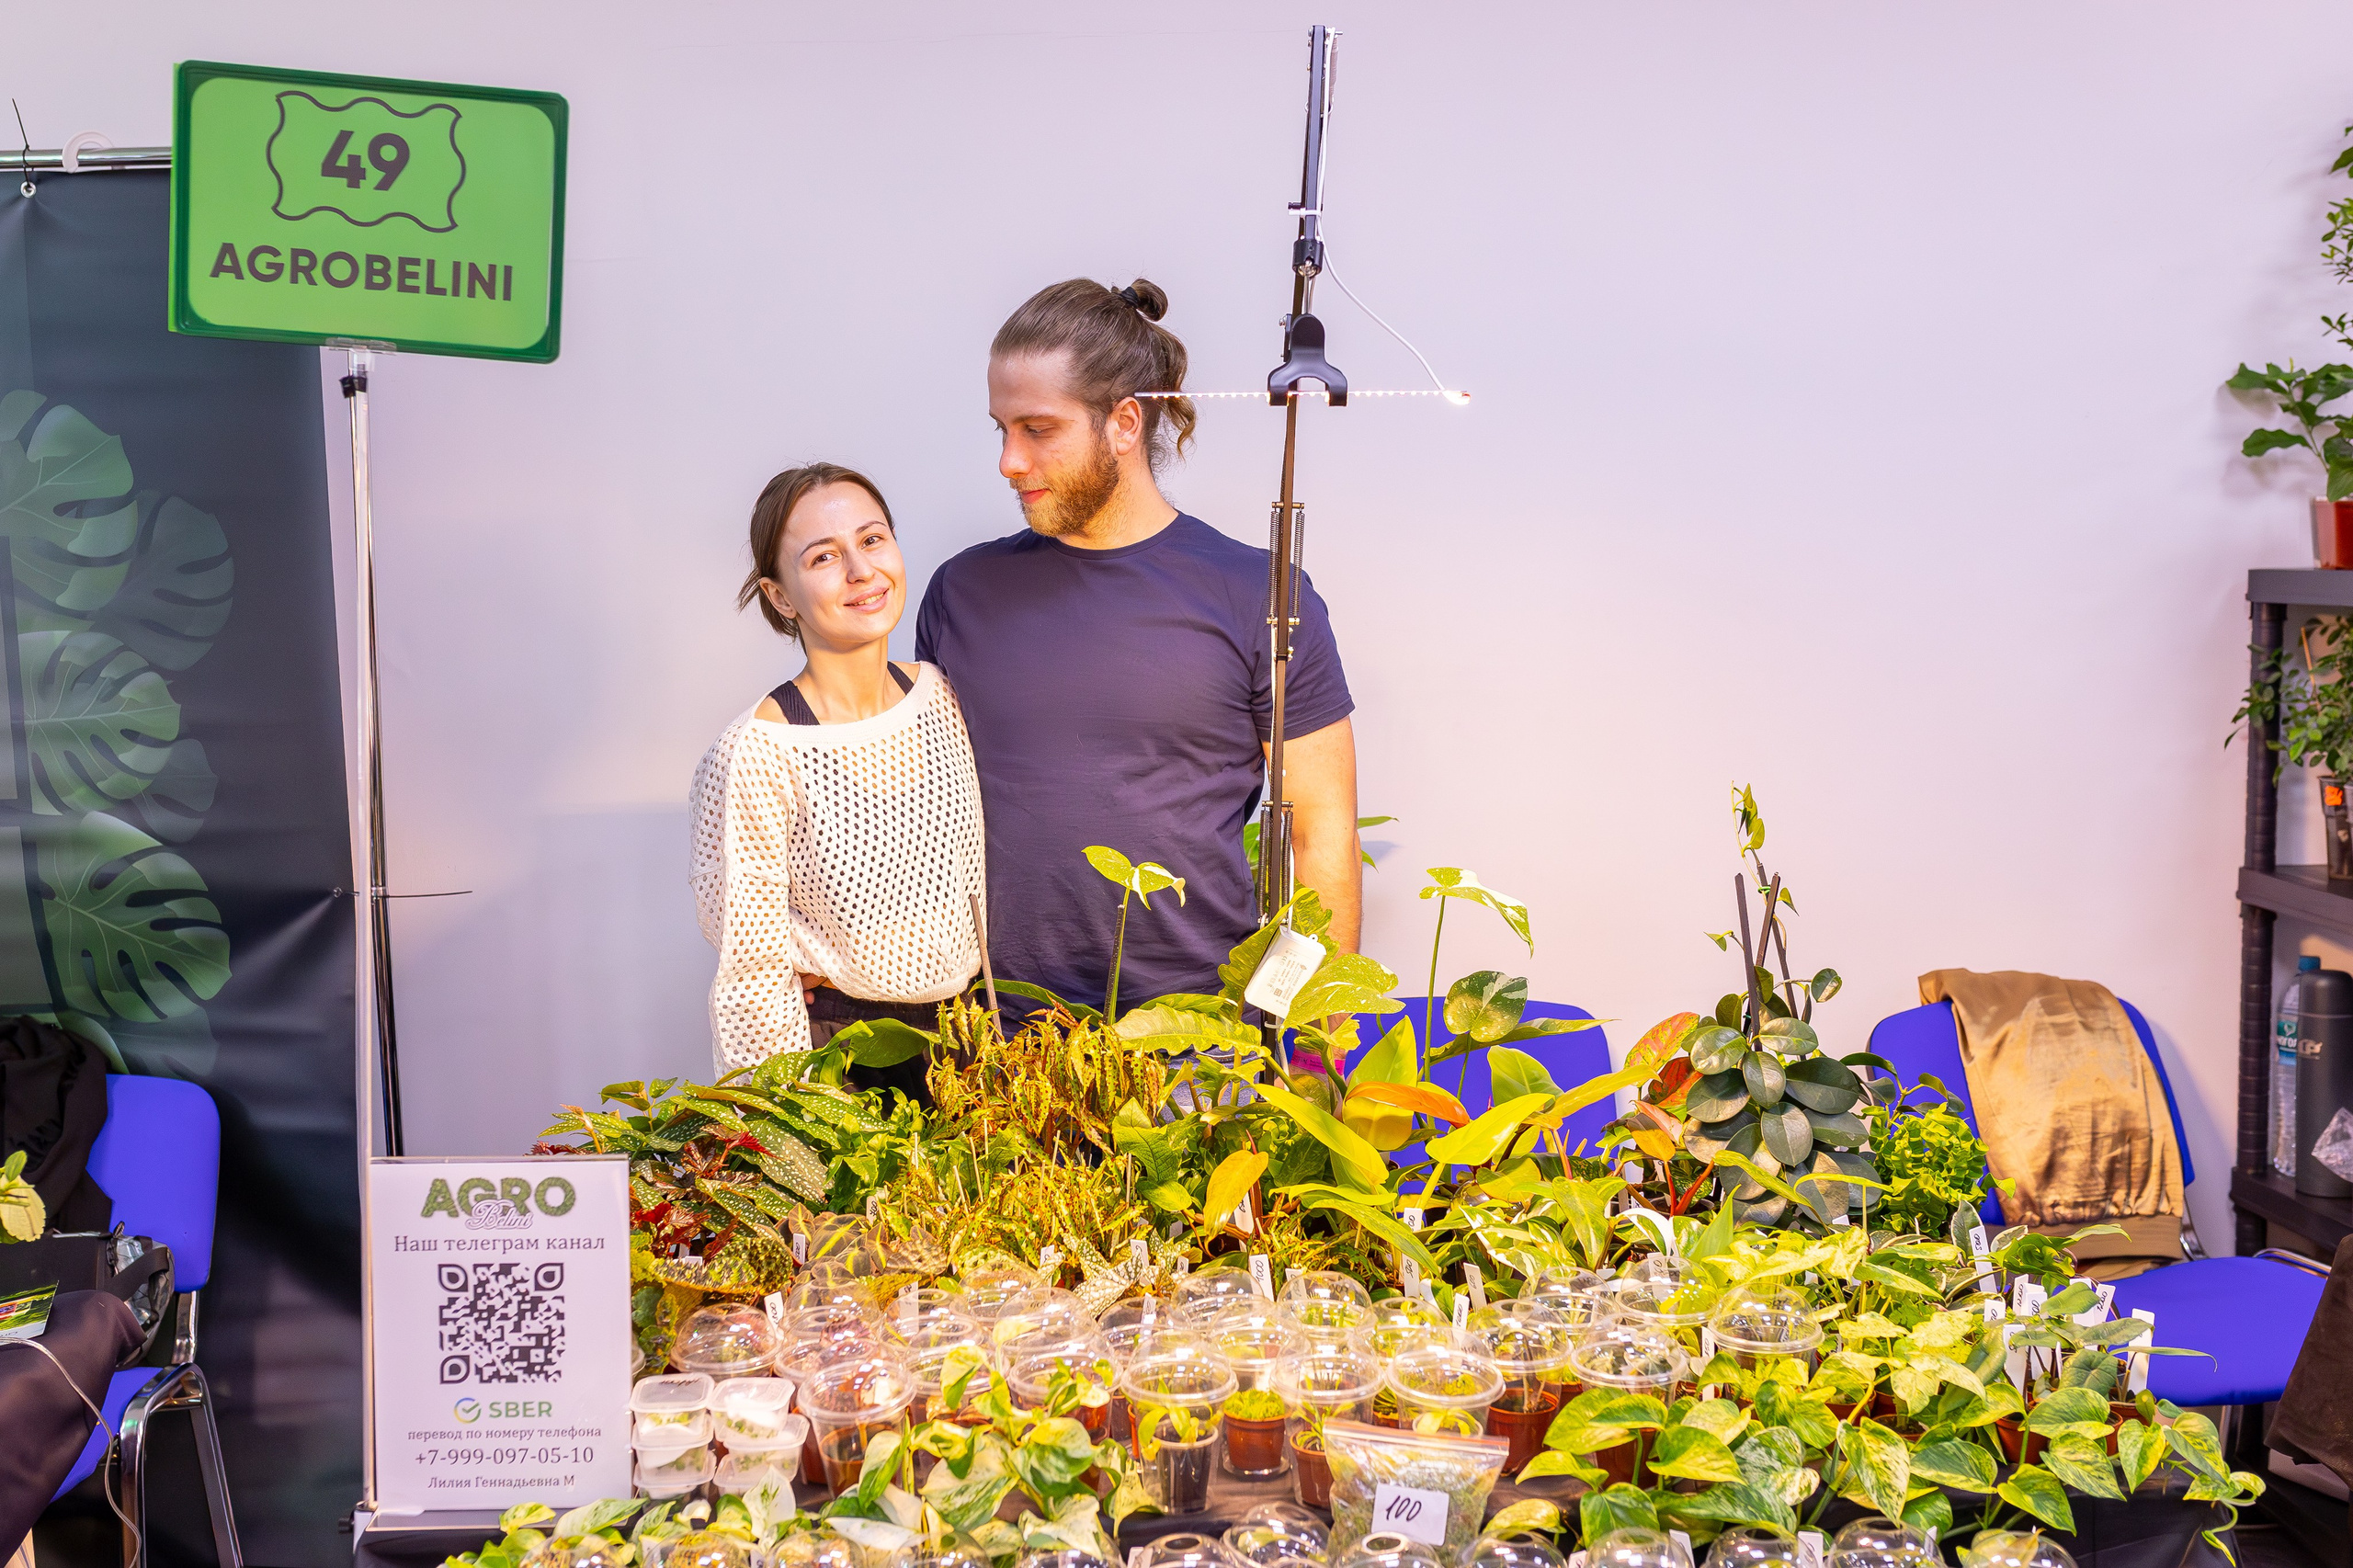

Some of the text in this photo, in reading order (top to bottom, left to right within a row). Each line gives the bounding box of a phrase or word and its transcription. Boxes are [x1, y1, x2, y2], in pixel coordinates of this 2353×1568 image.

[321, 130, 411, 192] 49
[210, 242, 513, 301] AGROBELINI
[420, 1176, 576, 1218] AGRO
[393, 1235, 606, 1255] Наш телеграм канал
[1256, 1260, 1264, 1282] 1000
[488, 1401, 552, 1418] SBER
[407, 1426, 602, 1442] перевод по номеру телефона
[415, 1446, 595, 1466] +7-999-097-05-10
[427, 1475, 575, 1490] Лилия Геннадьевна М
[1386, 1494, 1423, 1522] 100
